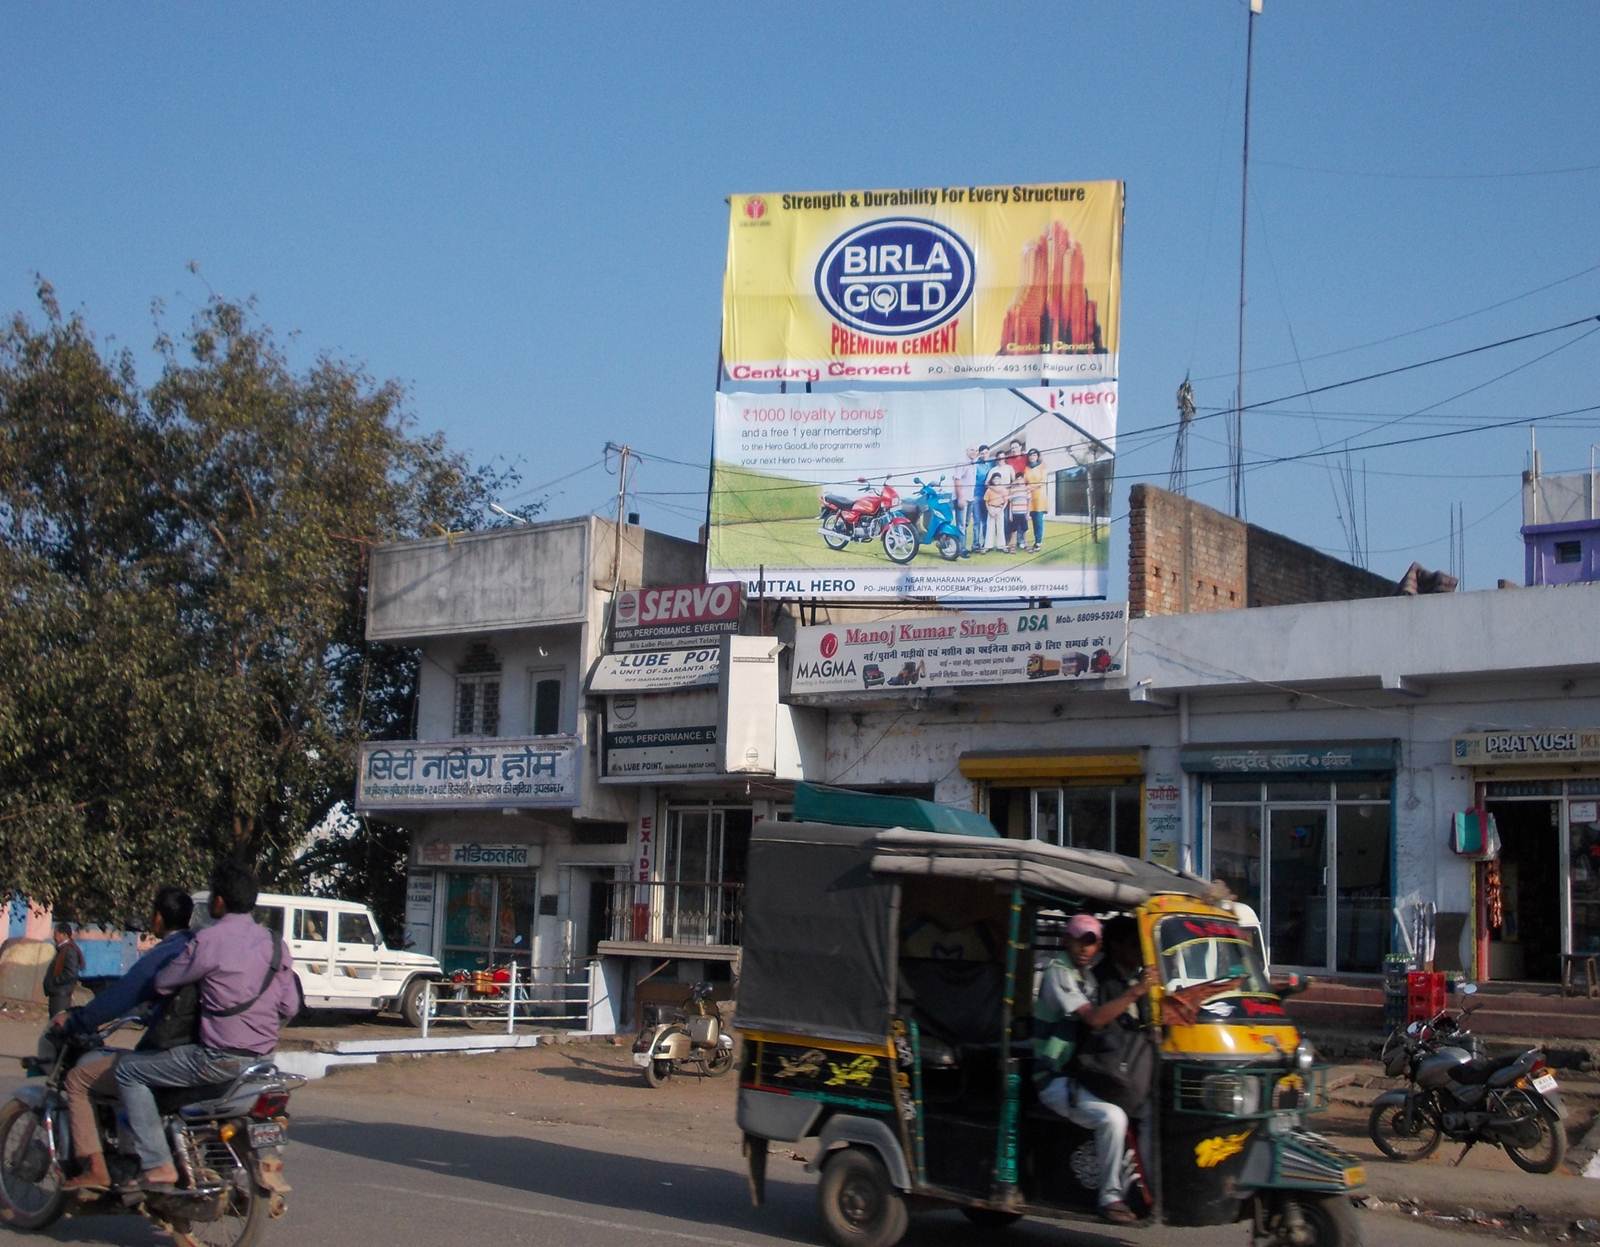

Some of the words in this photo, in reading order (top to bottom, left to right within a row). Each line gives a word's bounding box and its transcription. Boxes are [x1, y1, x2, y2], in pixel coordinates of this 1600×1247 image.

[783, 192, 846, 210] Strength
[850, 193, 859, 208] &
[864, 187, 938, 207] Durability
[942, 187, 964, 203] For
[968, 186, 1009, 204] Every
[1013, 185, 1085, 203] Structure
[844, 242, 950, 273] BIRLA
[844, 281, 946, 315] GOLD
[831, 322, 897, 355] PREMIUM
[902, 318, 959, 355] CEMENT
[733, 364, 819, 381] Century
[828, 362, 911, 376] Cement
[954, 364, 994, 374] Baikunth
[1003, 364, 1020, 373] 493
[1043, 362, 1073, 373] Raipur
[1071, 391, 1116, 405] Hero
[790, 408, 836, 423] loyalty
[742, 428, 759, 438] and
[761, 430, 767, 438] a
[770, 428, 789, 437] free
[800, 428, 822, 439] year
[824, 426, 882, 438] membership
[751, 443, 763, 451] the
[765, 443, 783, 451] Hero
[820, 442, 863, 452] programme
[864, 441, 881, 449] with
[741, 456, 758, 465] your
[778, 456, 796, 464] Hero
[749, 580, 806, 593] MITTAL
[811, 579, 856, 592] HERO
[642, 585, 732, 621] SERVO
[616, 629, 633, 639] 100%
[845, 625, 896, 647] Manoj
[899, 622, 957, 641] Kumar
[960, 617, 1009, 641] Singh
[1017, 614, 1049, 632] DSA
[941, 645, 962, 657] मशीन
[965, 646, 975, 655] का
[1011, 641, 1031, 652] कराने
[1035, 640, 1042, 650] के
[1045, 640, 1061, 650] लिए
[1065, 637, 1089, 648] सम्पर्क
[620, 652, 672, 667] LUBE
[683, 649, 720, 664] POI
[797, 659, 857, 679] MAGMA
[615, 736, 635, 745] 100%
[1486, 733, 1577, 753] PRATYUSH
[368, 749, 416, 781] सिटी
[502, 745, 562, 781] होम
[624, 762, 640, 771] LUBE
[639, 816, 652, 883] EXIDE
